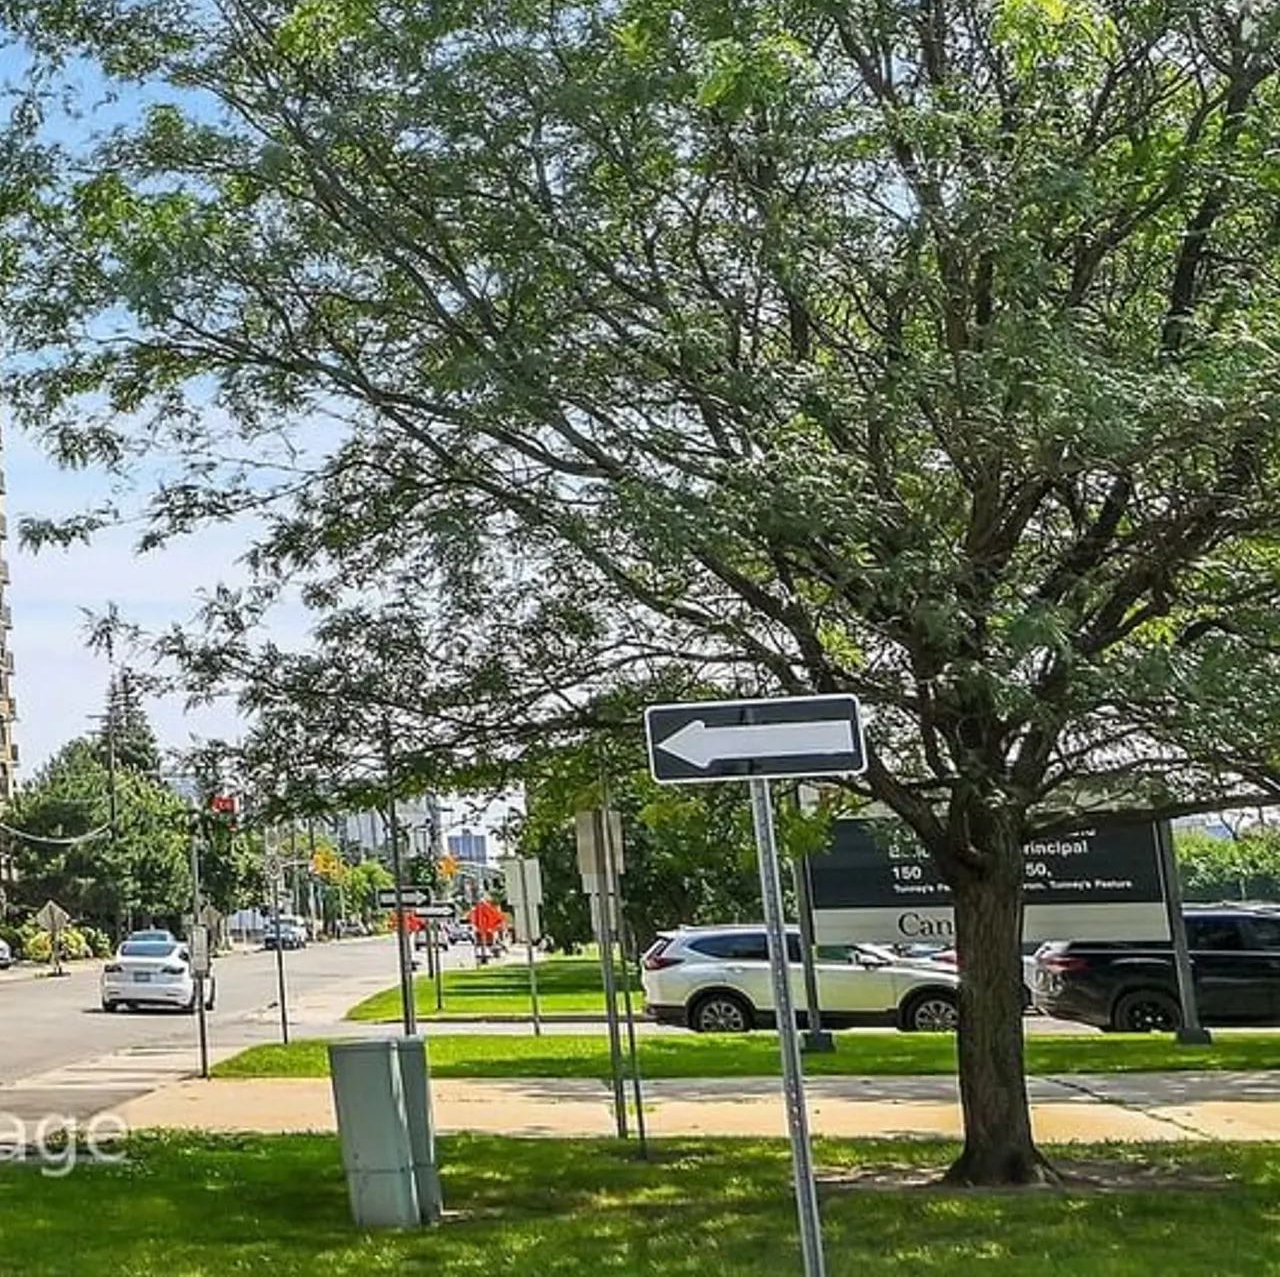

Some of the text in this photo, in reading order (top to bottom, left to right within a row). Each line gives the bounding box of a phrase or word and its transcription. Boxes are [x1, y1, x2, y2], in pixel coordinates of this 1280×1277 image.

[1023, 840, 1088, 858] rincipal
[891, 866, 922, 880] 150
[1025, 862, 1052, 877] 50,
[898, 911, 954, 937] Can
